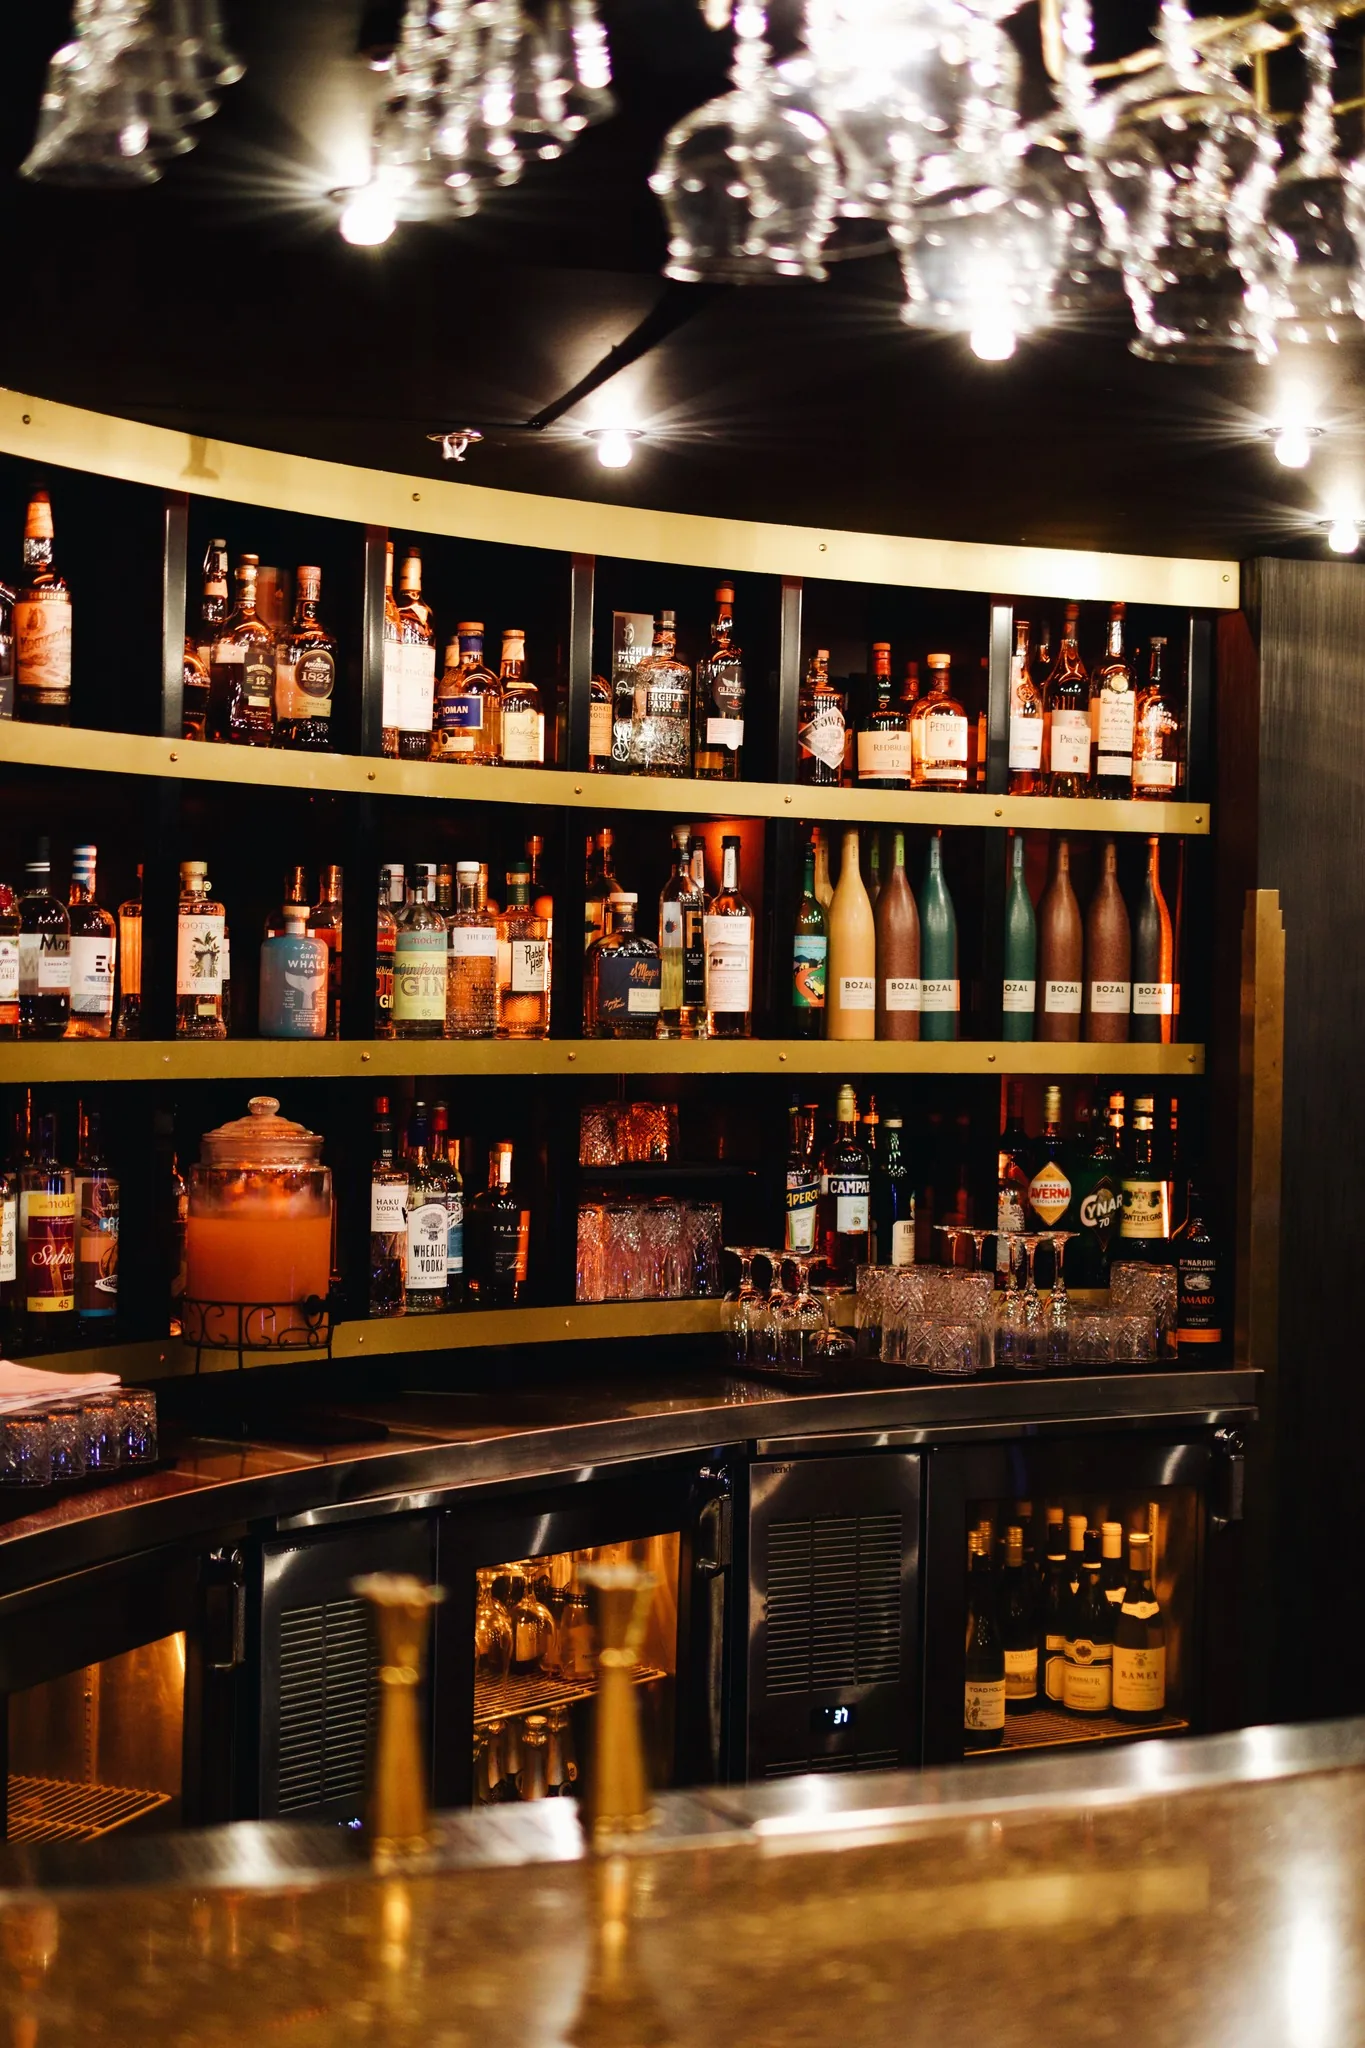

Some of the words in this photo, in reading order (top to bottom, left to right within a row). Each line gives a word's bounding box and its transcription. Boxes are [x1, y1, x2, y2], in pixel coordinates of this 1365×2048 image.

[255, 676, 266, 686] 12
[301, 671, 332, 683] 1824
[647, 700, 671, 709] PARK
[288, 960, 326, 969] WHALE
[401, 976, 445, 996] GIN
[845, 981, 873, 989] BOZAL
[891, 982, 918, 990] BOZAL
[922, 984, 952, 992] BOZAL
[1051, 985, 1078, 993] BOZAL
[1096, 985, 1125, 993] BOZAL
[1138, 987, 1167, 995] BOZAL
[1031, 1188, 1070, 1199] AVERNA
[376, 1198, 400, 1206] HAKU
[1080, 1193, 1123, 1227] CYNAR
[1099, 1218, 1110, 1228] 70
[58, 1300, 69, 1309] 45
[1180, 1295, 1215, 1305] AMARO
[1120, 1670, 1158, 1680] RAMEY
